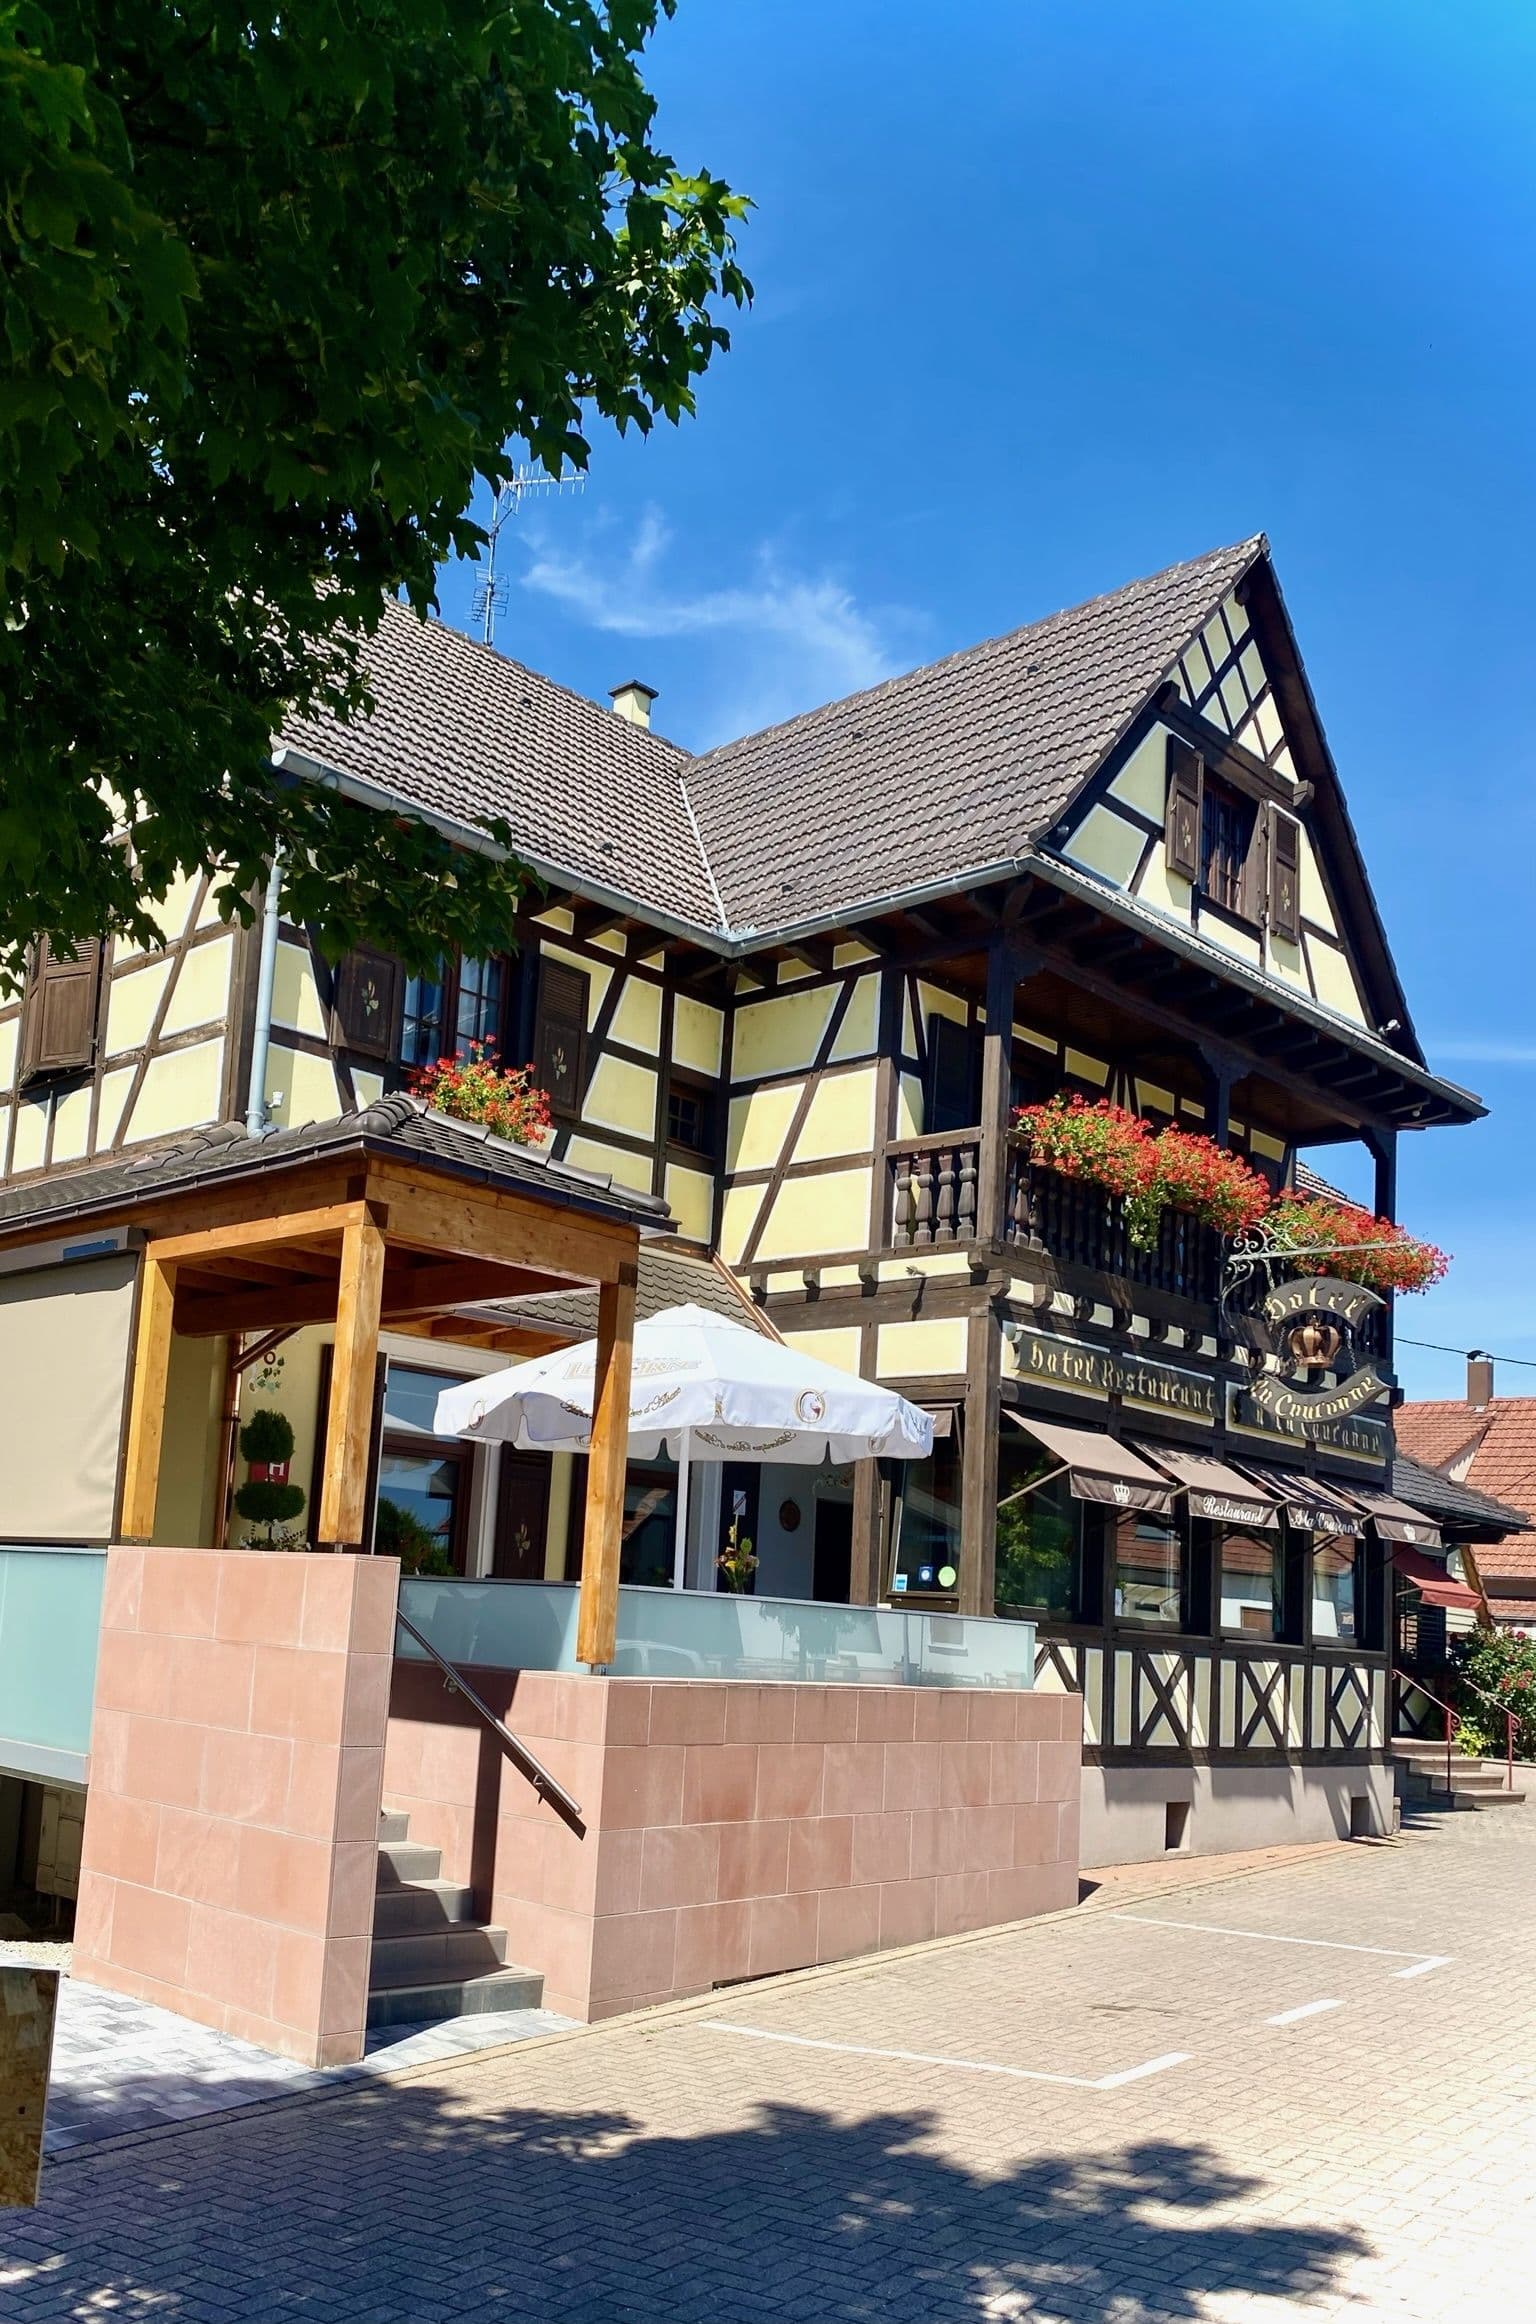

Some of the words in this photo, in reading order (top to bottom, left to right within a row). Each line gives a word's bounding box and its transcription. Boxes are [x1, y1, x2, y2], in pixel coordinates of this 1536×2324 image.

[1265, 1280, 1367, 1320] Hotel
[1101, 1358, 1216, 1412] Restaurant
[1275, 1376, 1377, 1419] Couronne
[1203, 1494, 1264, 1524] Restaurant
